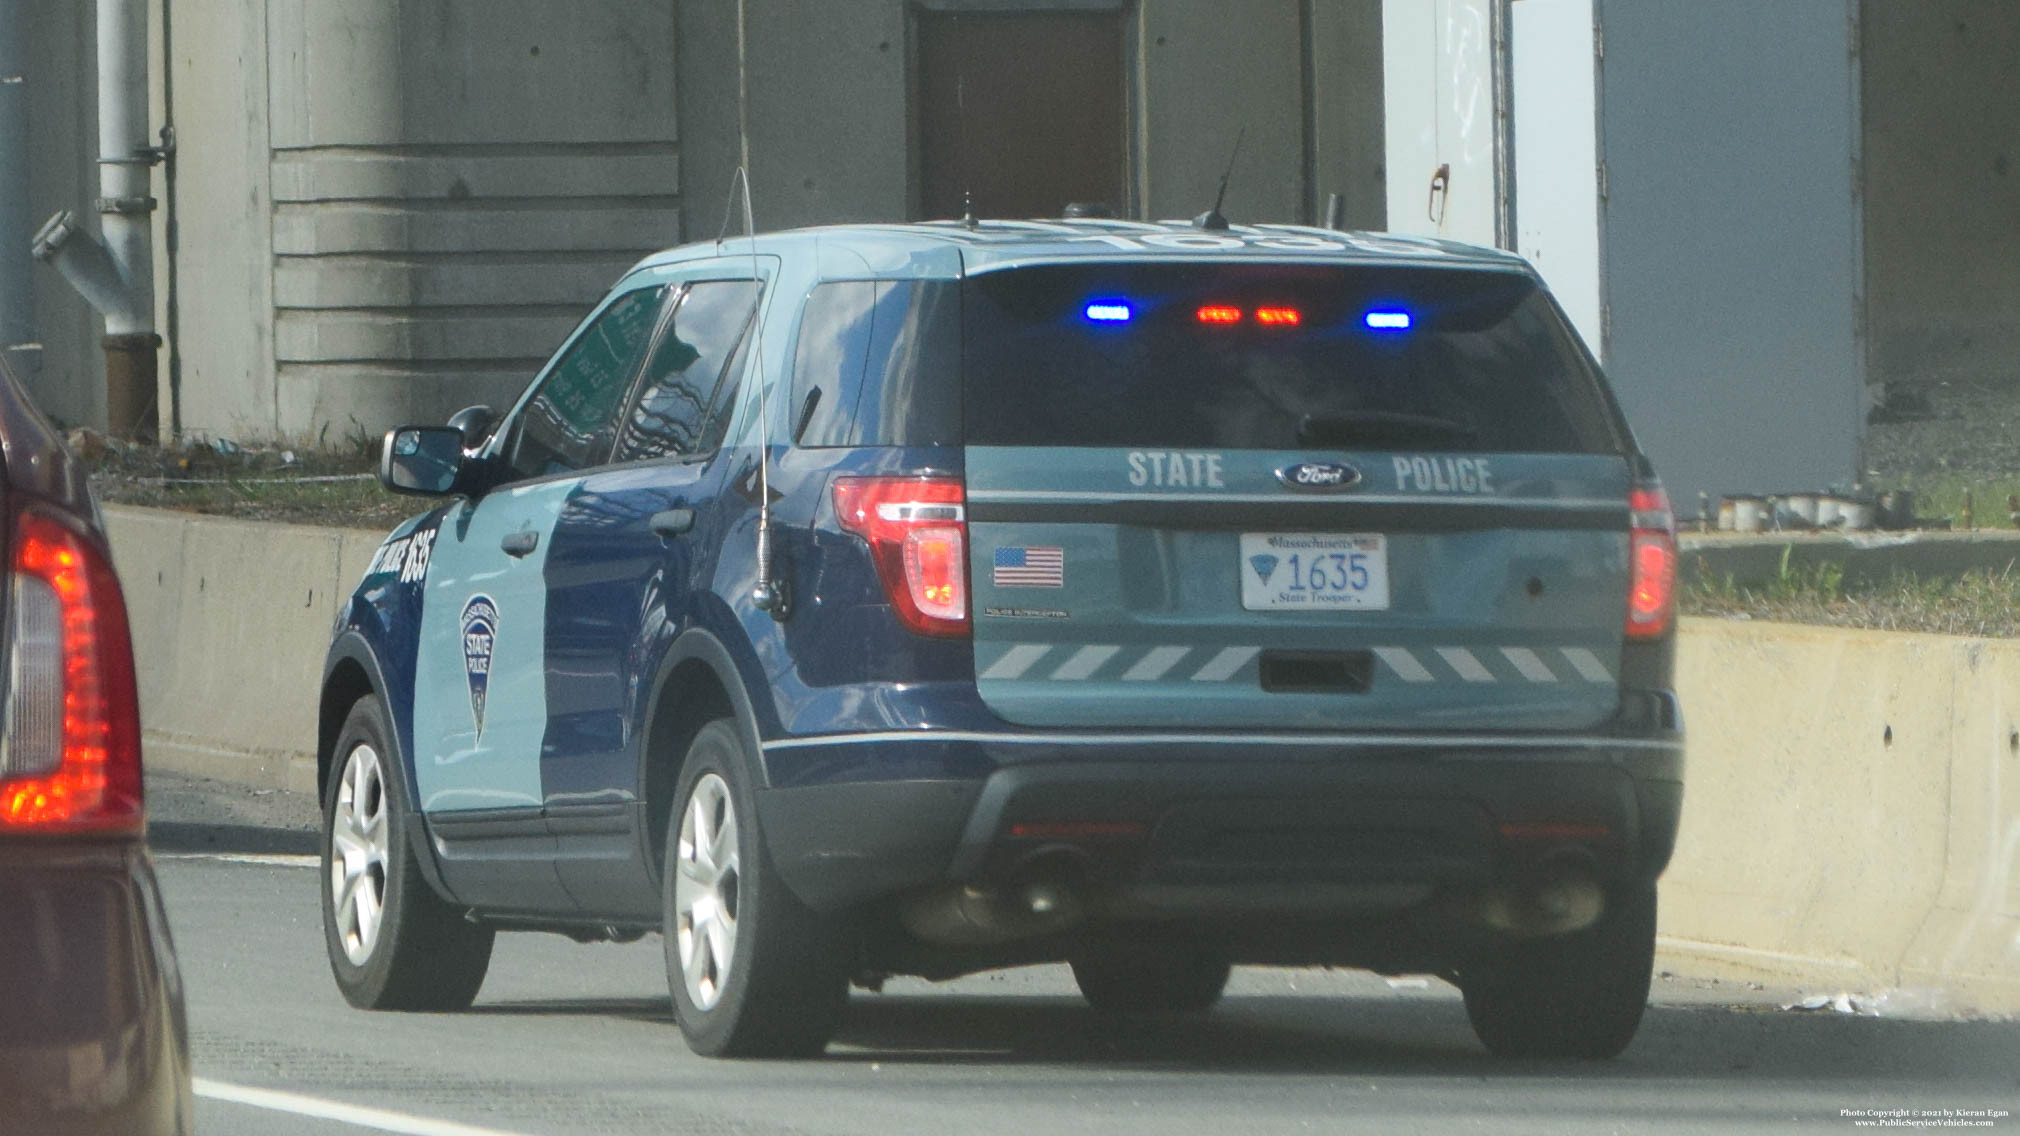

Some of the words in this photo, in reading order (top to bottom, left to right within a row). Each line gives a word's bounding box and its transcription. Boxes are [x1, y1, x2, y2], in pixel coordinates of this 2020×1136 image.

[1127, 451, 1224, 488] STATE
[1297, 465, 1343, 484] Ford
[1393, 456, 1494, 493] POLICE
[1271, 536, 1353, 549] Massachusetts
[1289, 553, 1369, 591] 1635
[1279, 592, 1307, 603] State
[1311, 592, 1352, 604] Trooper
[466, 634, 491, 656] STATE
[468, 657, 489, 673] POLICE
